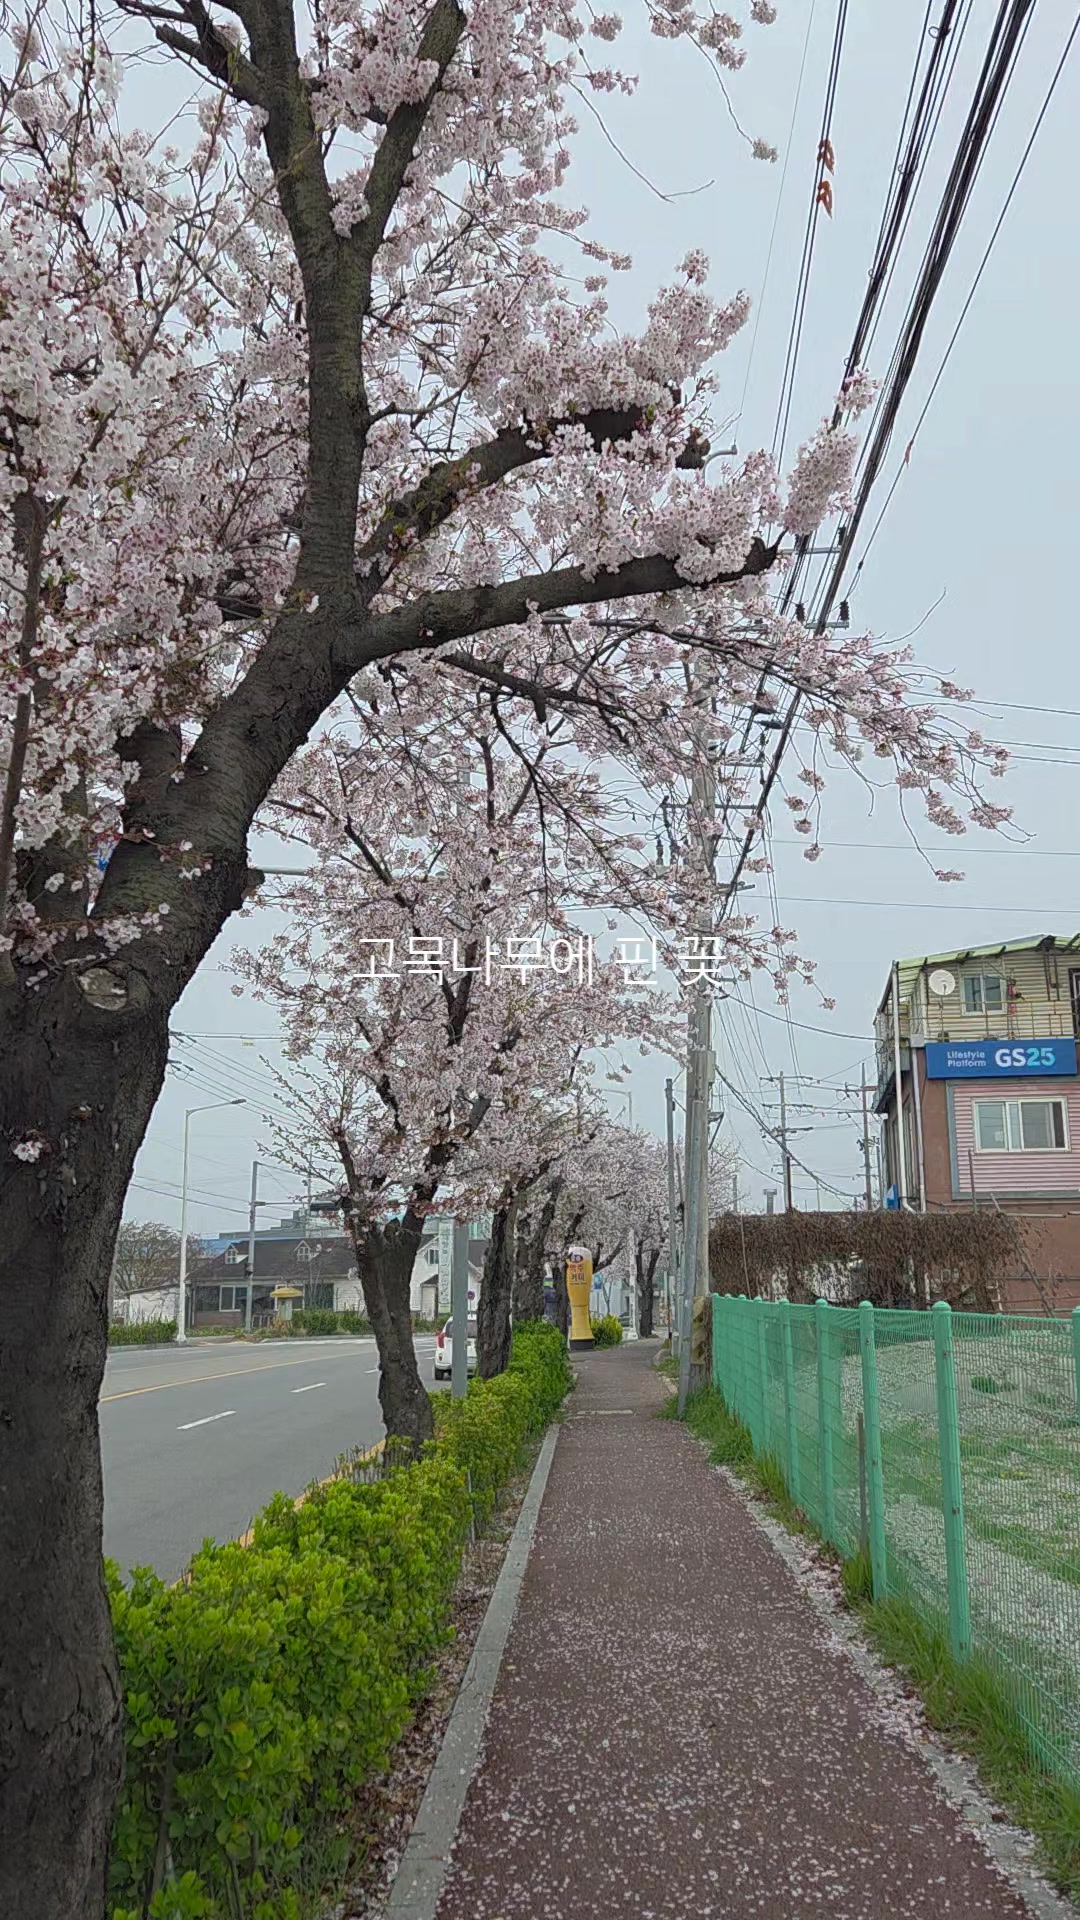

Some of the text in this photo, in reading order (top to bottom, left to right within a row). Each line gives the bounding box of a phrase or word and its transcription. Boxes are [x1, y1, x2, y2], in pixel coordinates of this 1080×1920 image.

[947, 1050, 985, 1060] Lifestyle
[995, 1047, 1056, 1068] GS25
[947, 1060, 987, 1068] Platform
